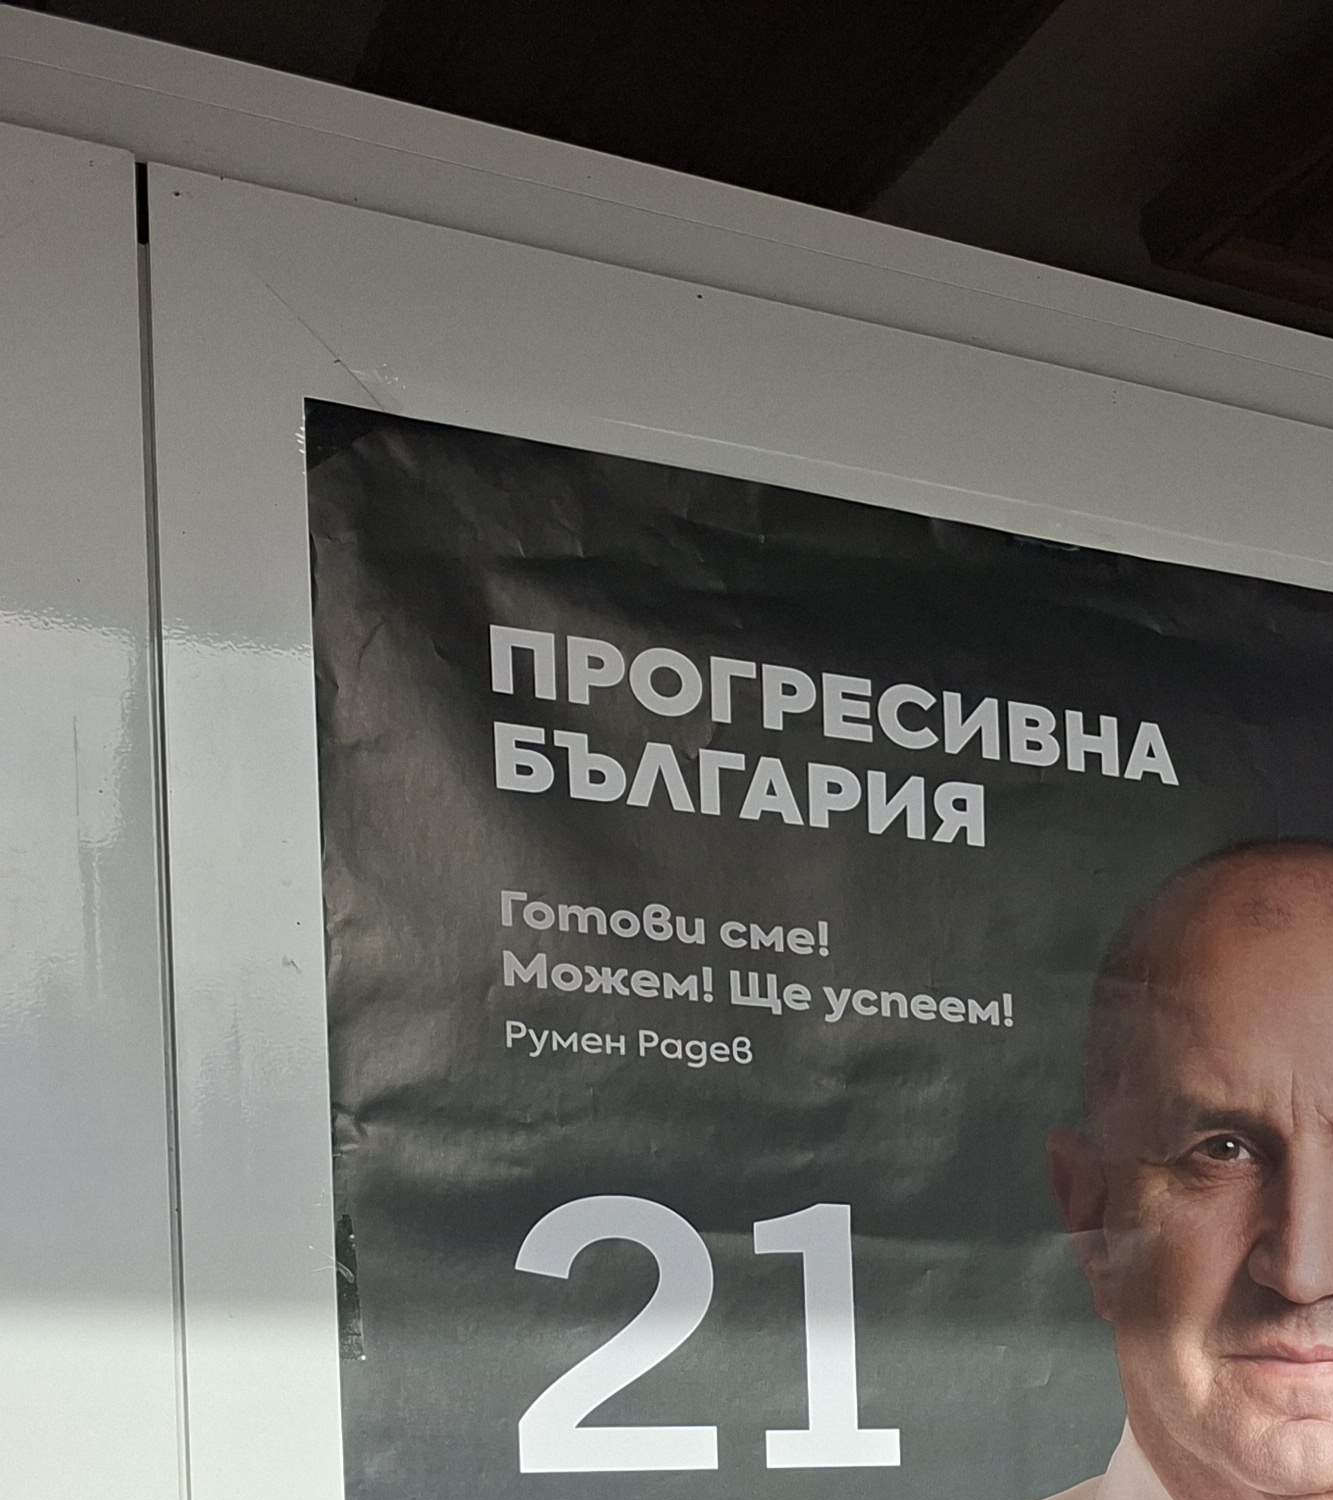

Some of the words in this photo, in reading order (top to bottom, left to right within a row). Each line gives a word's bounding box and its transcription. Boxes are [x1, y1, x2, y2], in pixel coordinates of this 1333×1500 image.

[489, 624, 1180, 787] ПРОГРЕСИВНА
[493, 721, 987, 848] БЪЛГАРИЯ
[500, 890, 706, 946] Готови
[719, 920, 831, 957] сме!
[502, 949, 715, 1003] Можем!
[728, 970, 812, 1016] Ще
[822, 986, 1015, 1028] успеем!
[505, 1020, 626, 1058] Румен
[638, 1029, 754, 1067] Радев
[515, 1196, 902, 1473] 21
